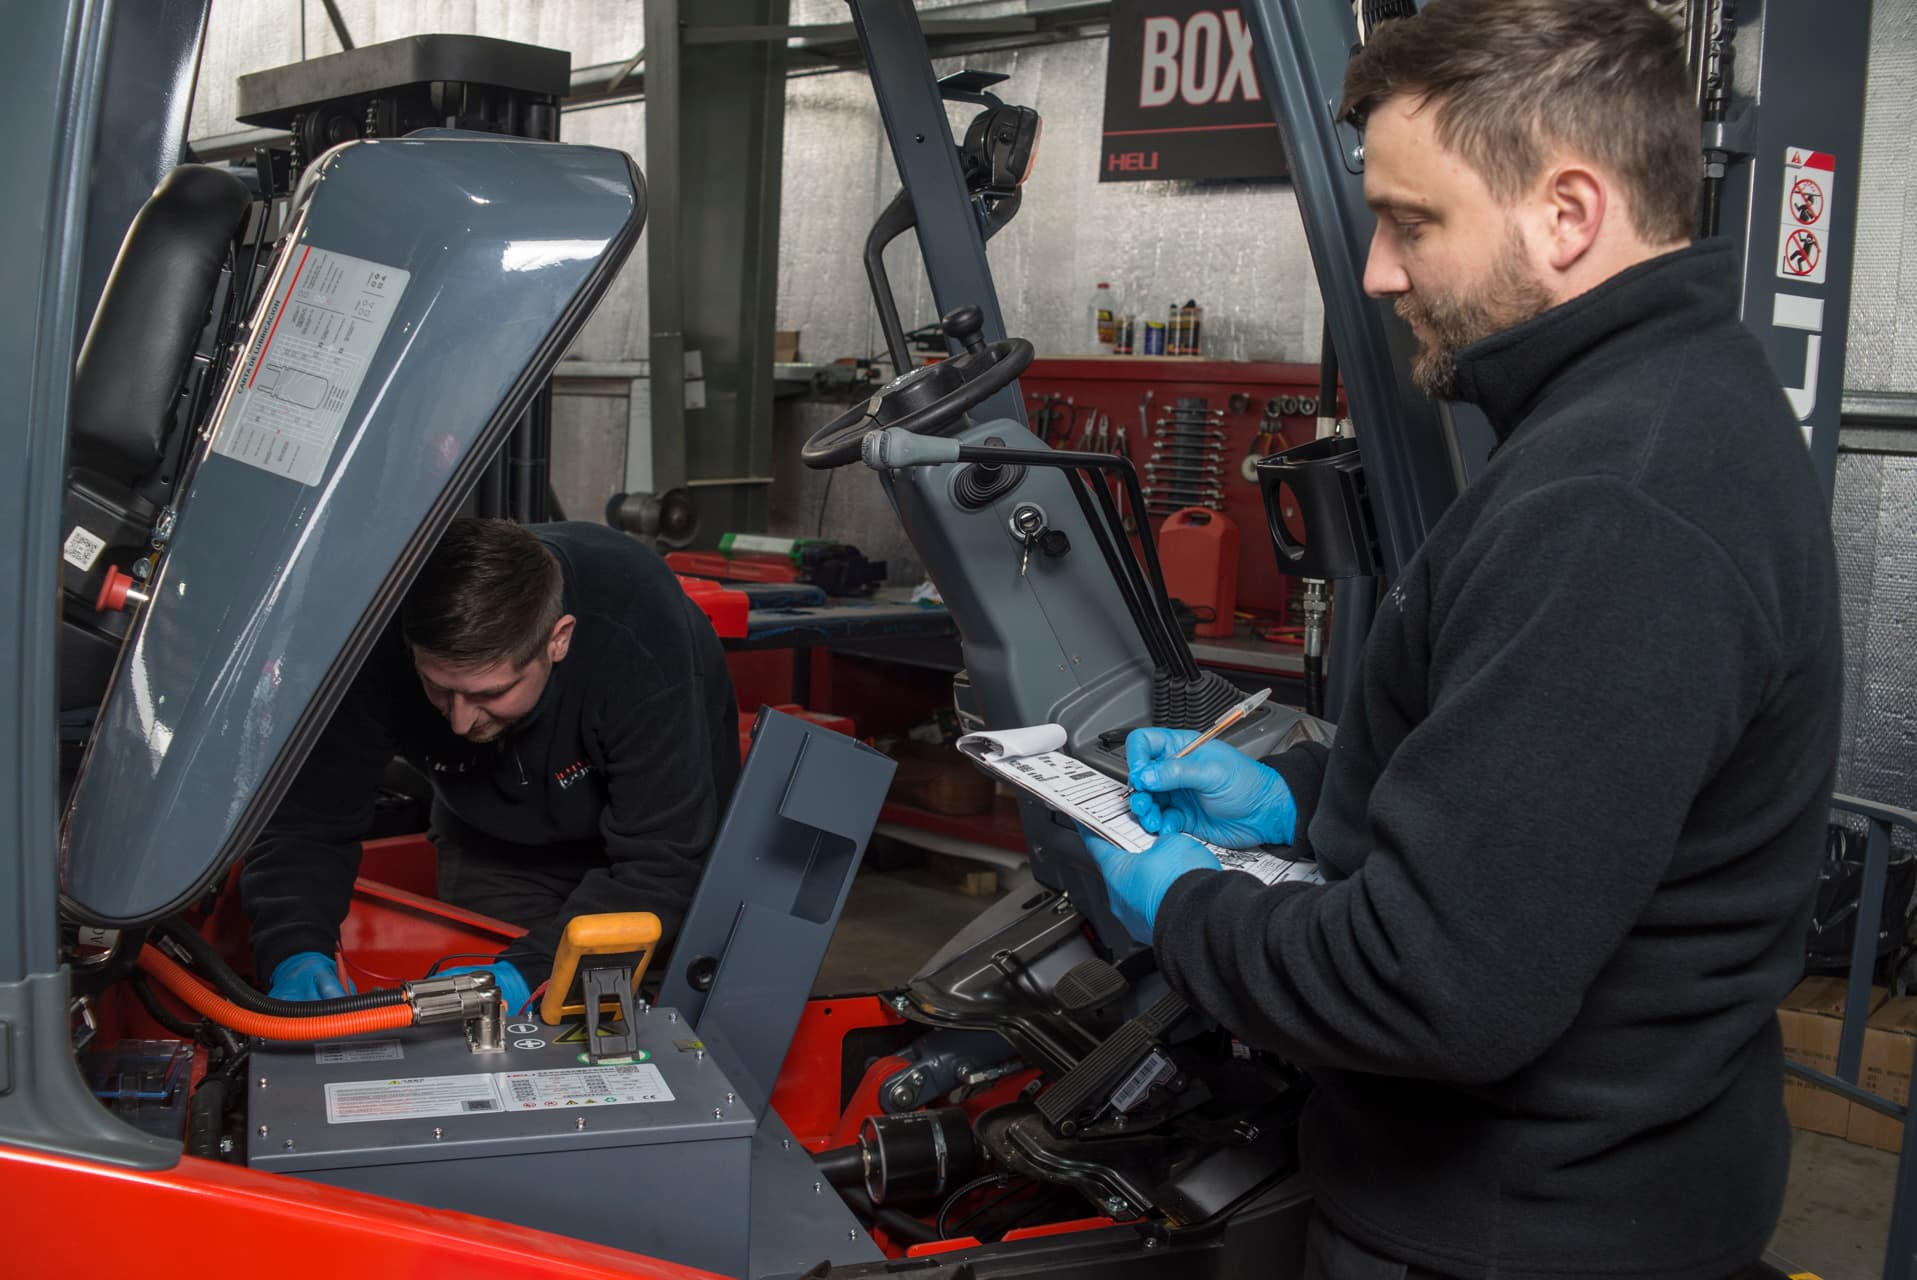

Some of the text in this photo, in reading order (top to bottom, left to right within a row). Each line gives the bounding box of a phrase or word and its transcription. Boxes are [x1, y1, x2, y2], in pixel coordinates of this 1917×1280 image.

[1138, 8, 1262, 108] BOX
[1107, 151, 1160, 172] HELI
[237, 369, 250, 394] CARTA
